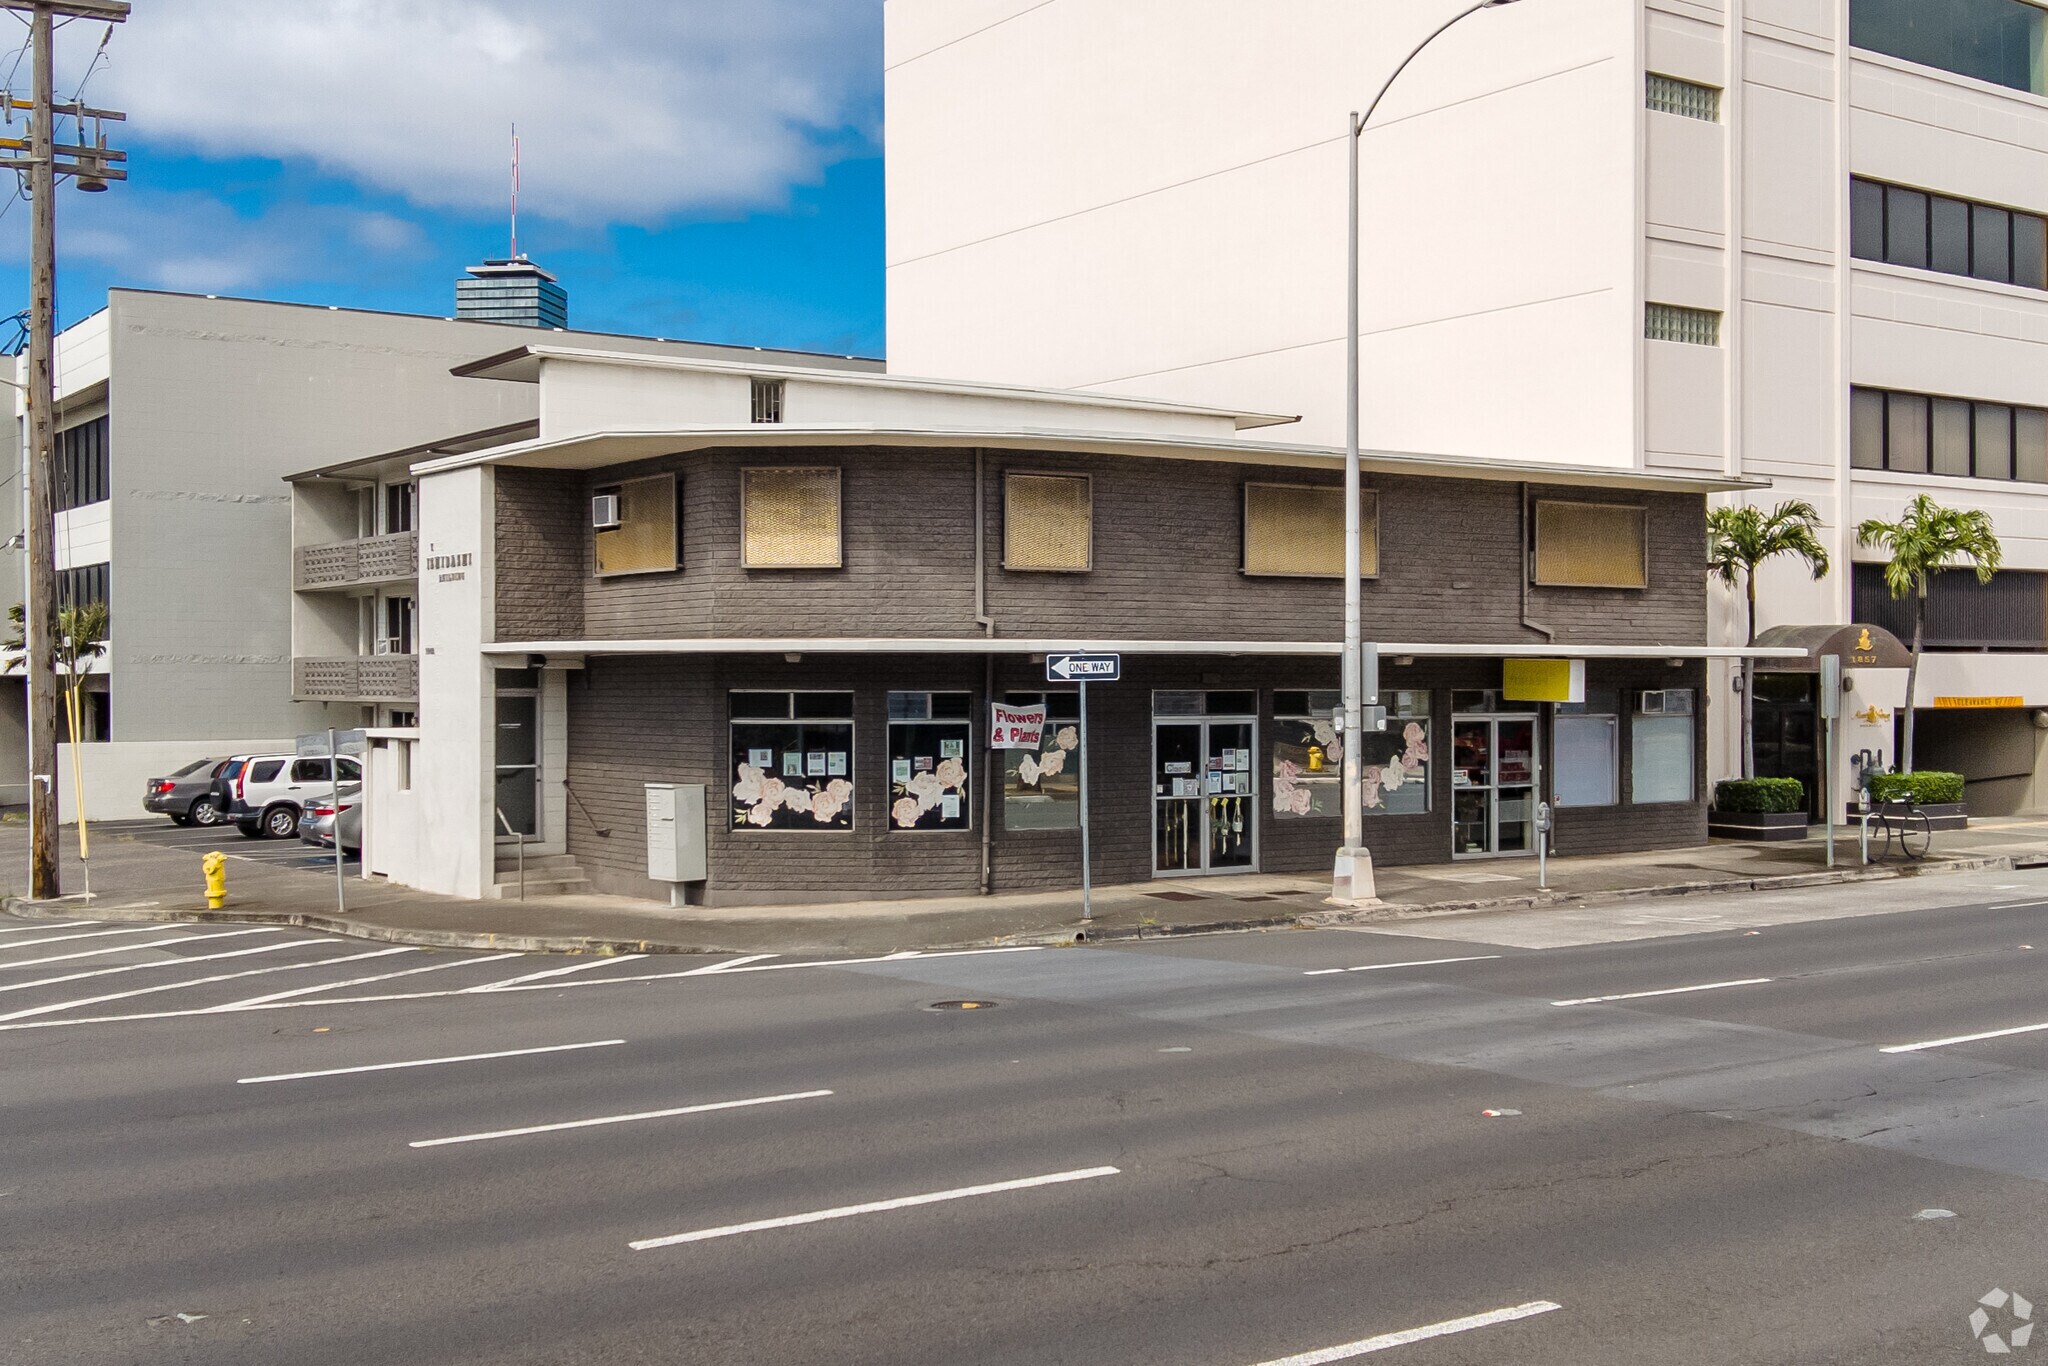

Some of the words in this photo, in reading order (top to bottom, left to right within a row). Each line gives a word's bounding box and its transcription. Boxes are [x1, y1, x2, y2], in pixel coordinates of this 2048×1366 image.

[1069, 662, 1089, 672] ONE
[1091, 662, 1111, 672] WAY
[995, 708, 1044, 725] Flowers
[992, 727, 1005, 743] &
[1010, 727, 1040, 743] Plants
